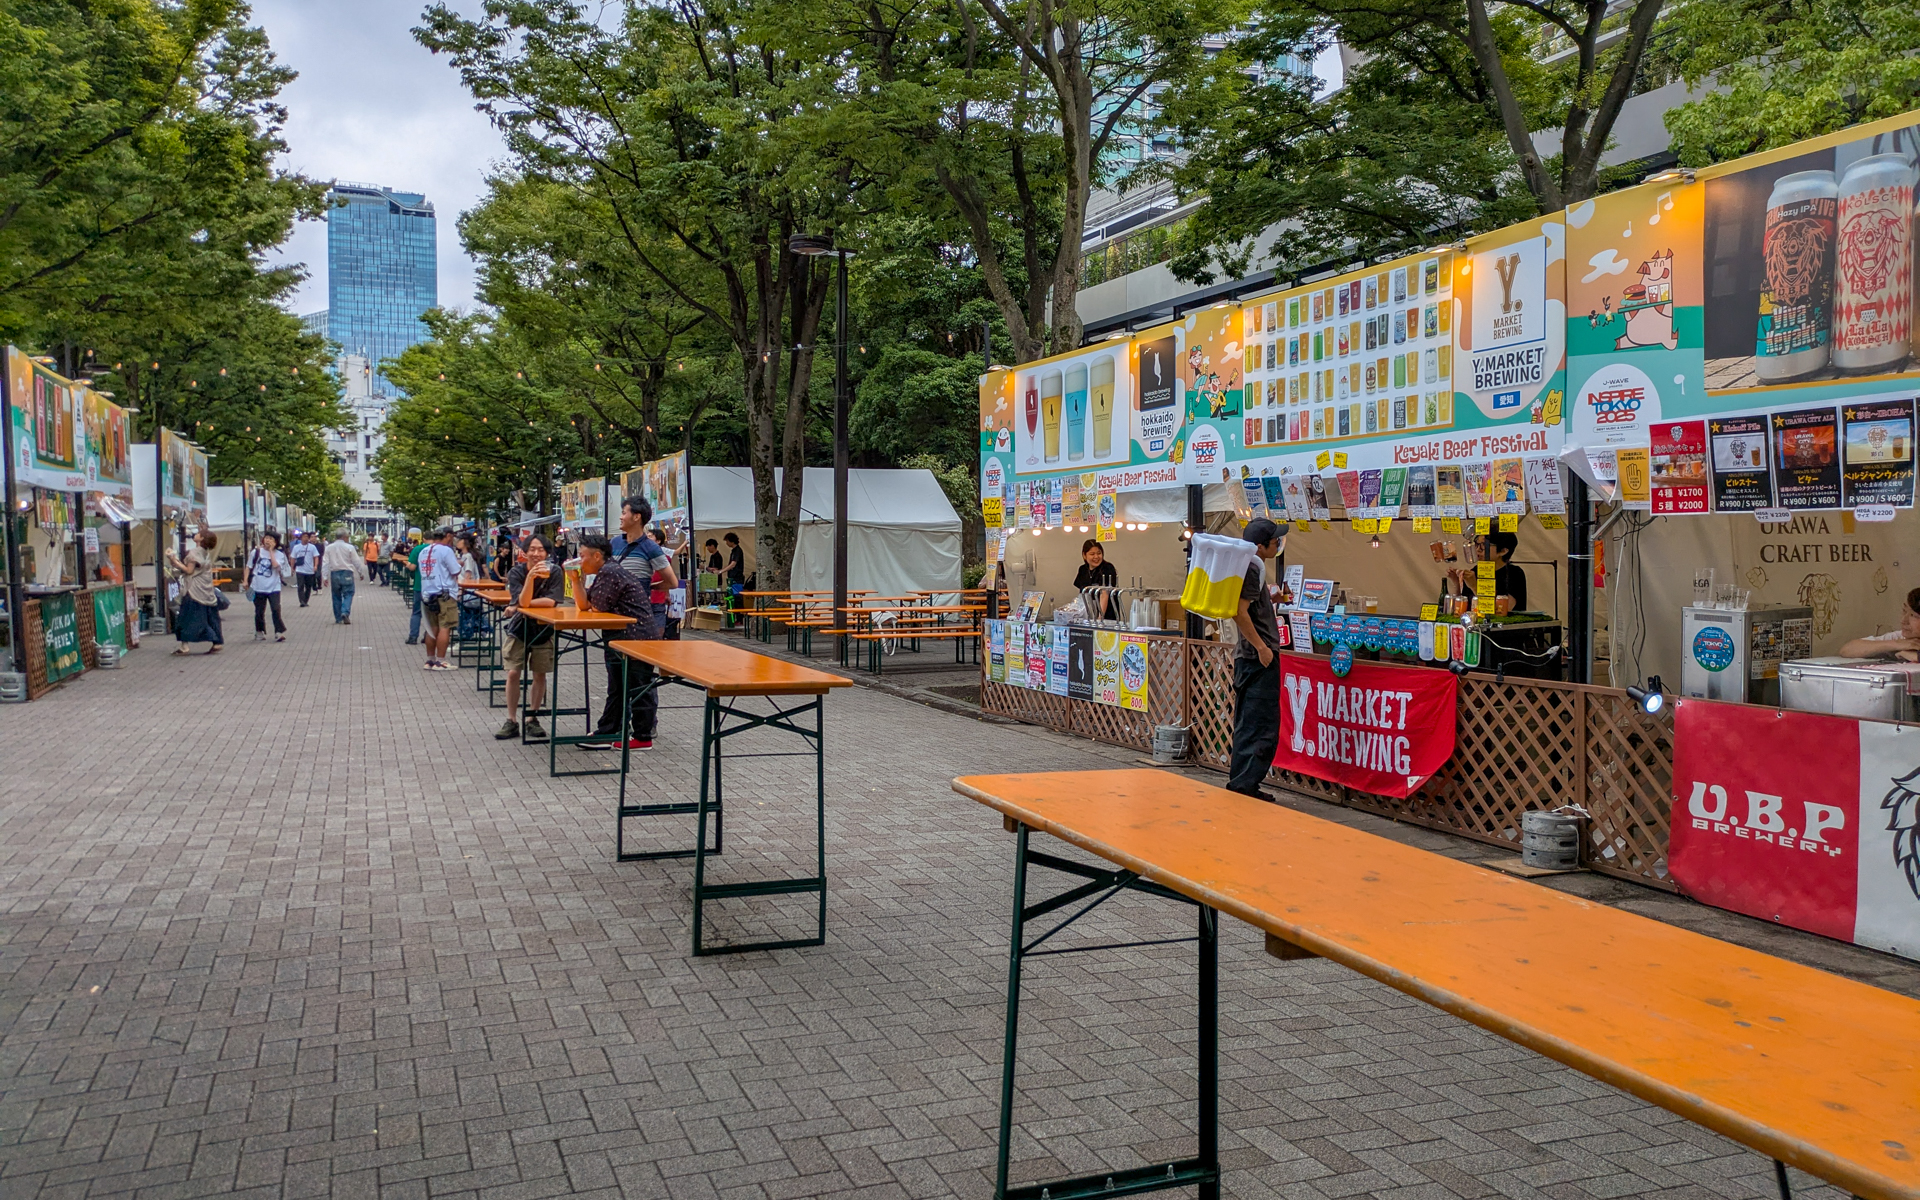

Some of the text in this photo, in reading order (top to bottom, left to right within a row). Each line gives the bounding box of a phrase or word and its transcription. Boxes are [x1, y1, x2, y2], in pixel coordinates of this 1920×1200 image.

[1778, 204, 1817, 218] Hazy IPA
[1494, 314, 1522, 329] MARKET
[1493, 325, 1522, 340] BREWING
[1472, 347, 1544, 373] Y.MARKET
[1475, 365, 1540, 389] BREWING
[1500, 394, 1514, 406] 愛知
[1592, 398, 1641, 414] TOKYO
[1141, 410, 1174, 426] hokkaido
[1597, 408, 1636, 424] 2025
[1785, 417, 1807, 425] URAWA
[1142, 424, 1172, 437] brewing
[1194, 448, 1216, 458] TOKYO
[1394, 430, 1548, 464] Keyaki Beer Festival
[1196, 455, 1214, 464] 2025
[1099, 467, 1176, 488] Keyaki Beer Festival
[1527, 460, 1543, 498] アルト
[1542, 458, 1559, 485] 純生
[1798, 475, 1818, 484] ビター
[1843, 470, 1913, 480] ベルジャンウィット
[1658, 488, 1703, 498] 4種 ¥1700
[1880, 494, 1885, 502] S
[1887, 494, 1906, 502] ¥600
[1658, 501, 1703, 510] 5種 ¥2000
[1761, 516, 1831, 534] URAWA
[1760, 544, 1873, 563] CRAFT BEER
[1317, 681, 1413, 730] MARKET
[1317, 722, 1411, 775] BREWING
[1688, 781, 1845, 843] U.B.P
[1692, 818, 1841, 857] BREWERY
